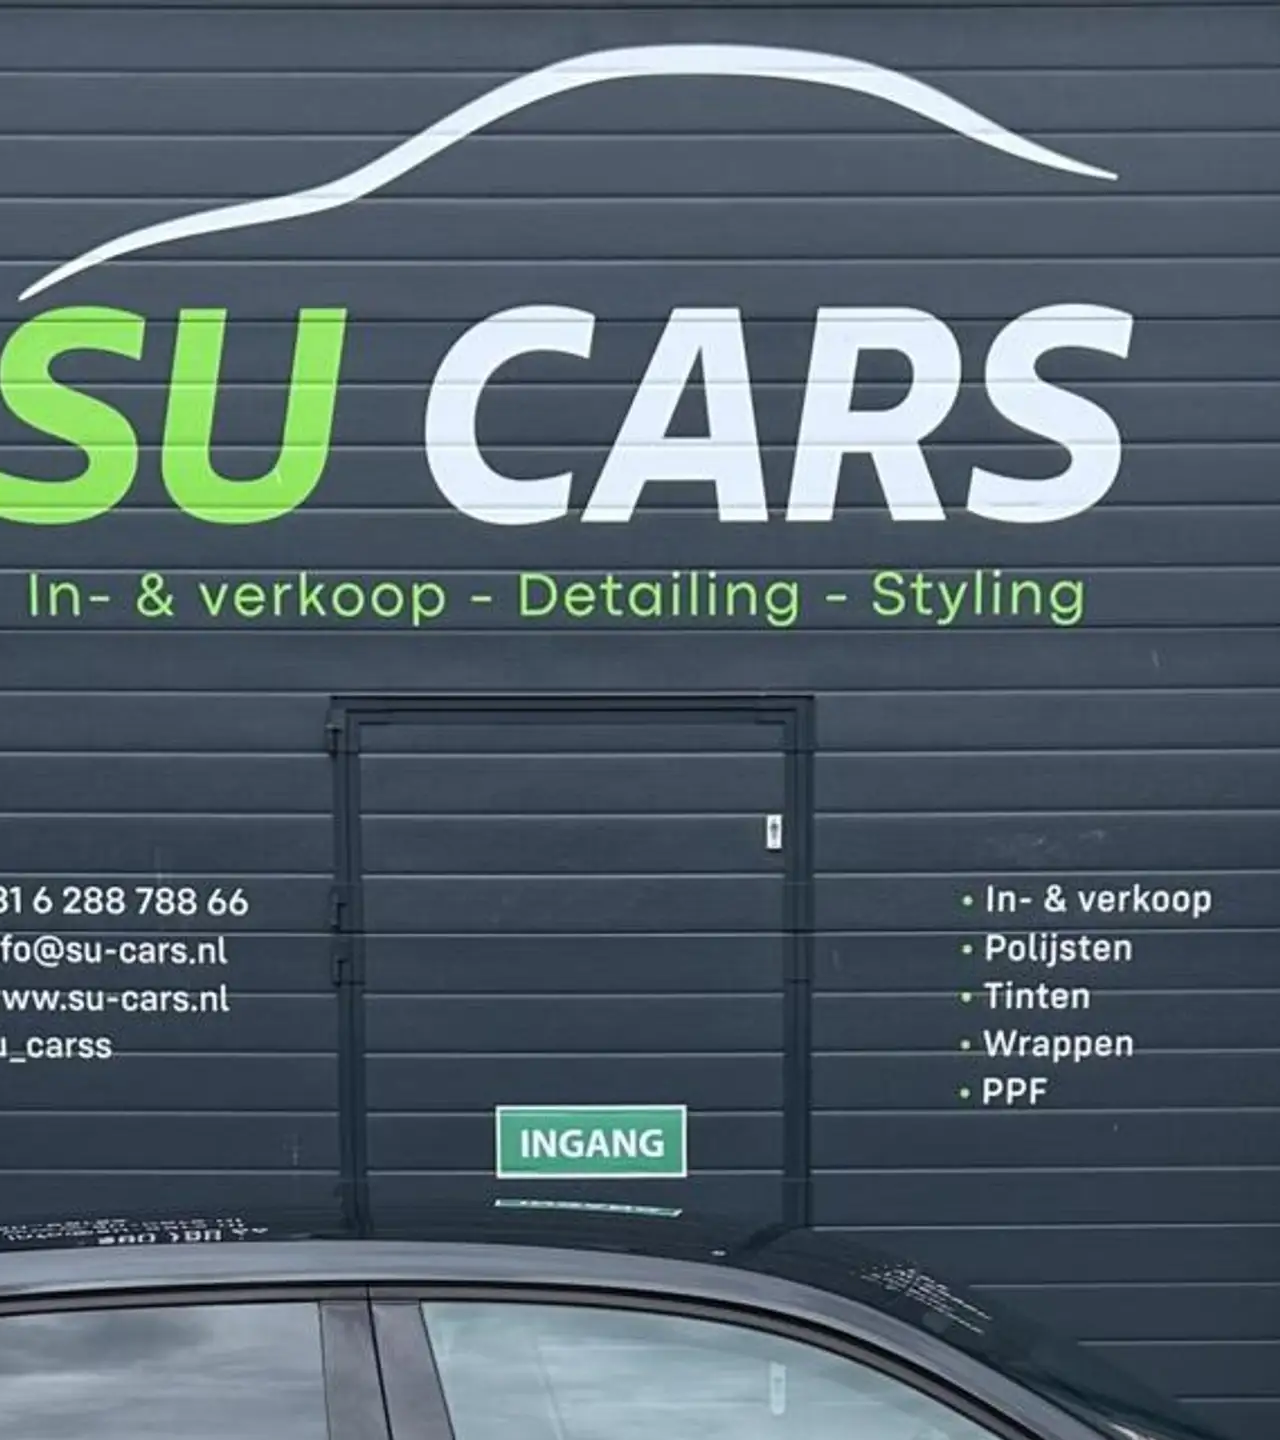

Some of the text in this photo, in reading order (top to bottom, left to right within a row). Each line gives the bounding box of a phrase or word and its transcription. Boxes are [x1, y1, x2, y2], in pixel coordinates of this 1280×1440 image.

[424, 303, 1133, 525] CARS
[28, 574, 111, 617] In-
[136, 574, 174, 617] &
[198, 574, 446, 628] verkoop
[517, 572, 801, 627] Detailing
[871, 568, 1087, 627] Styling
[32, 885, 54, 914] 6
[62, 886, 127, 915] 288
[134, 887, 198, 916] 788
[206, 888, 250, 916] 66
[986, 883, 1212, 918] In- & verkoop
[985, 934, 1132, 968] Polijsten
[983, 981, 1090, 1010] Tinten
[982, 1029, 1134, 1063] Wrappen
[982, 1077, 1048, 1105] PPF
[520, 1128, 665, 1158] INGANG
